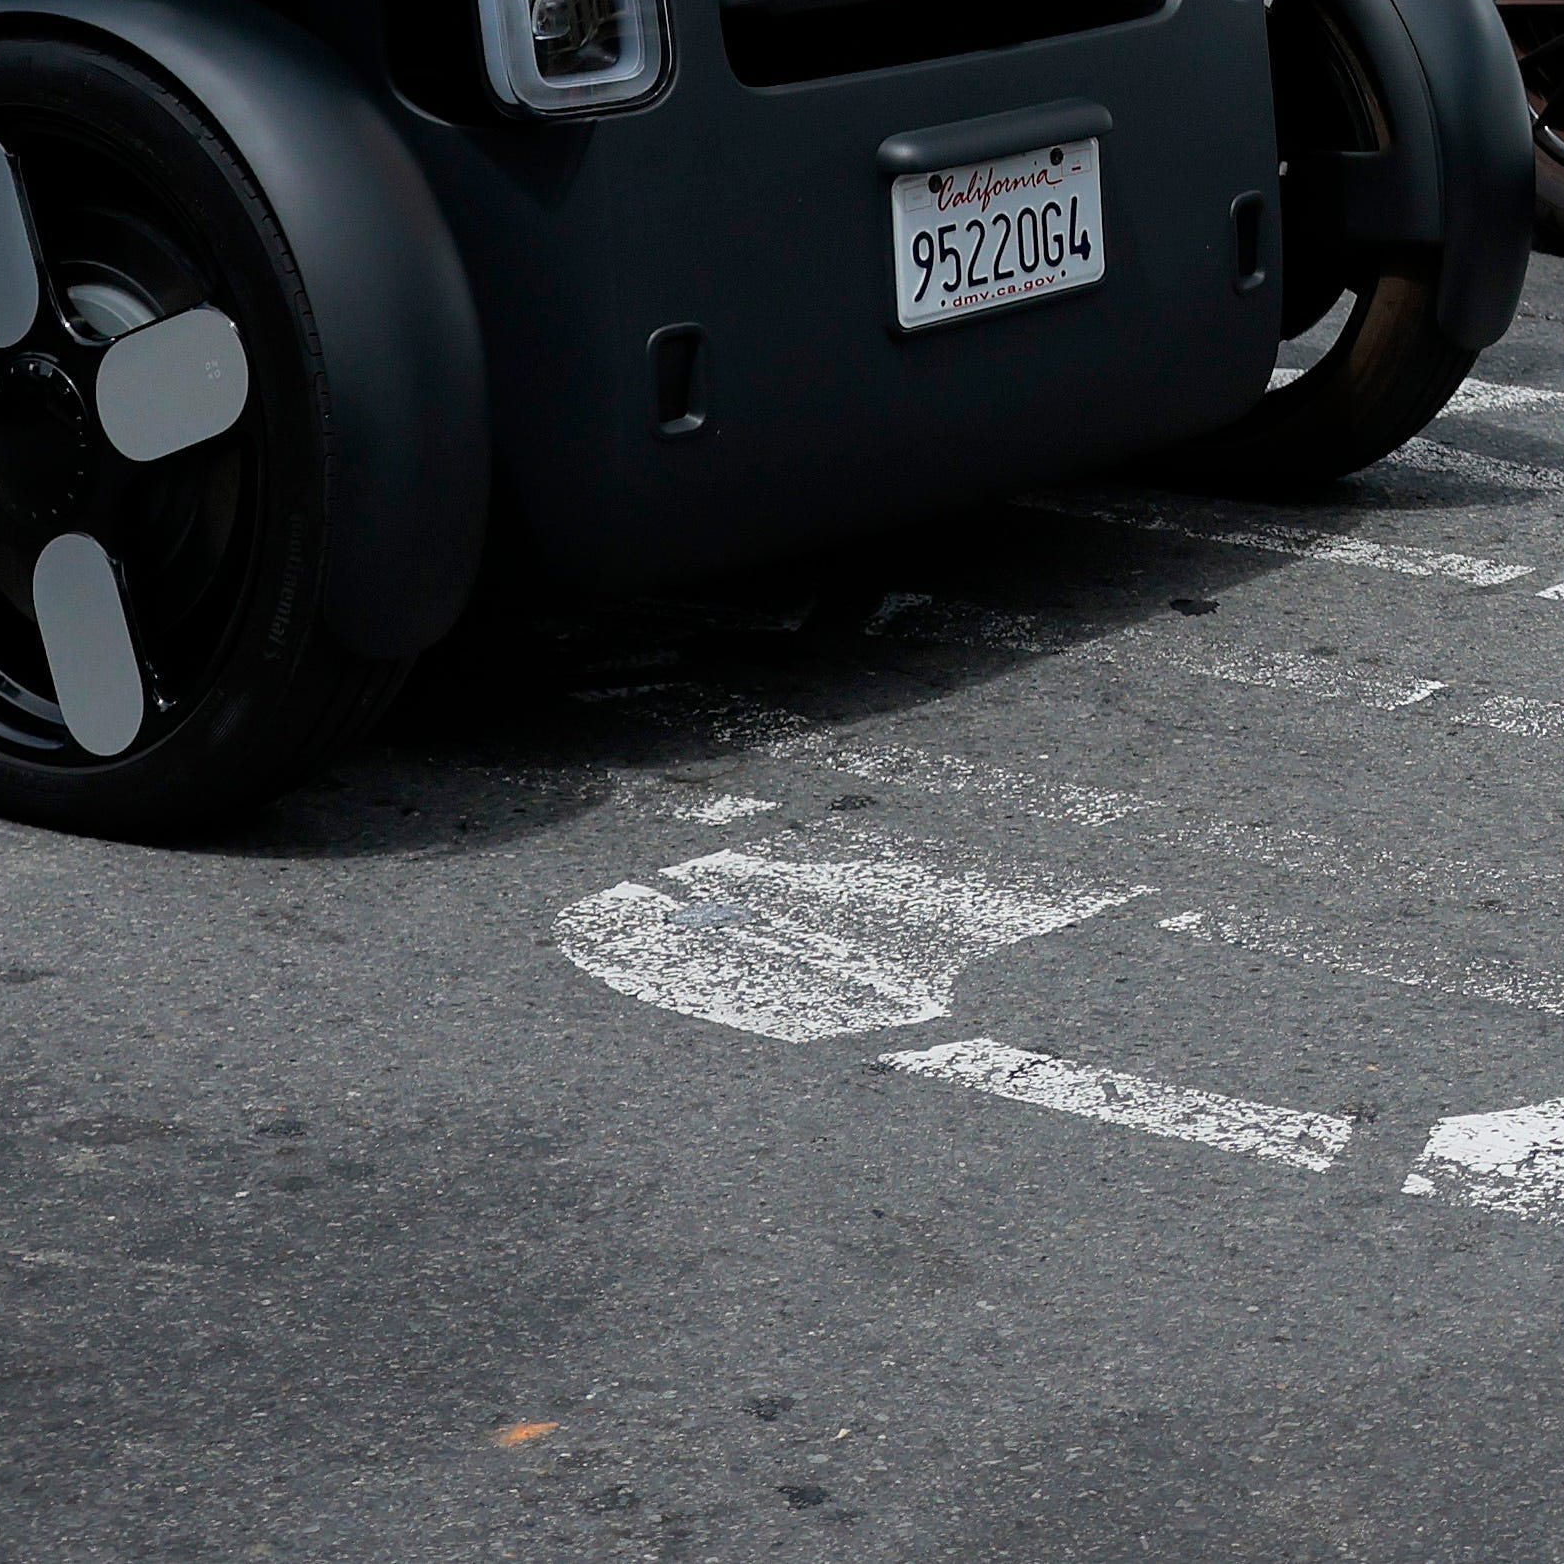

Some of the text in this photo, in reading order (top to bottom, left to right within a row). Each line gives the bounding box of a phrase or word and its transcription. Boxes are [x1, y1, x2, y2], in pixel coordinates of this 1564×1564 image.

[937, 167, 1063, 212] California
[912, 195, 1092, 303] 95220G4
[952, 274, 1056, 308] dmv.ca.gov
